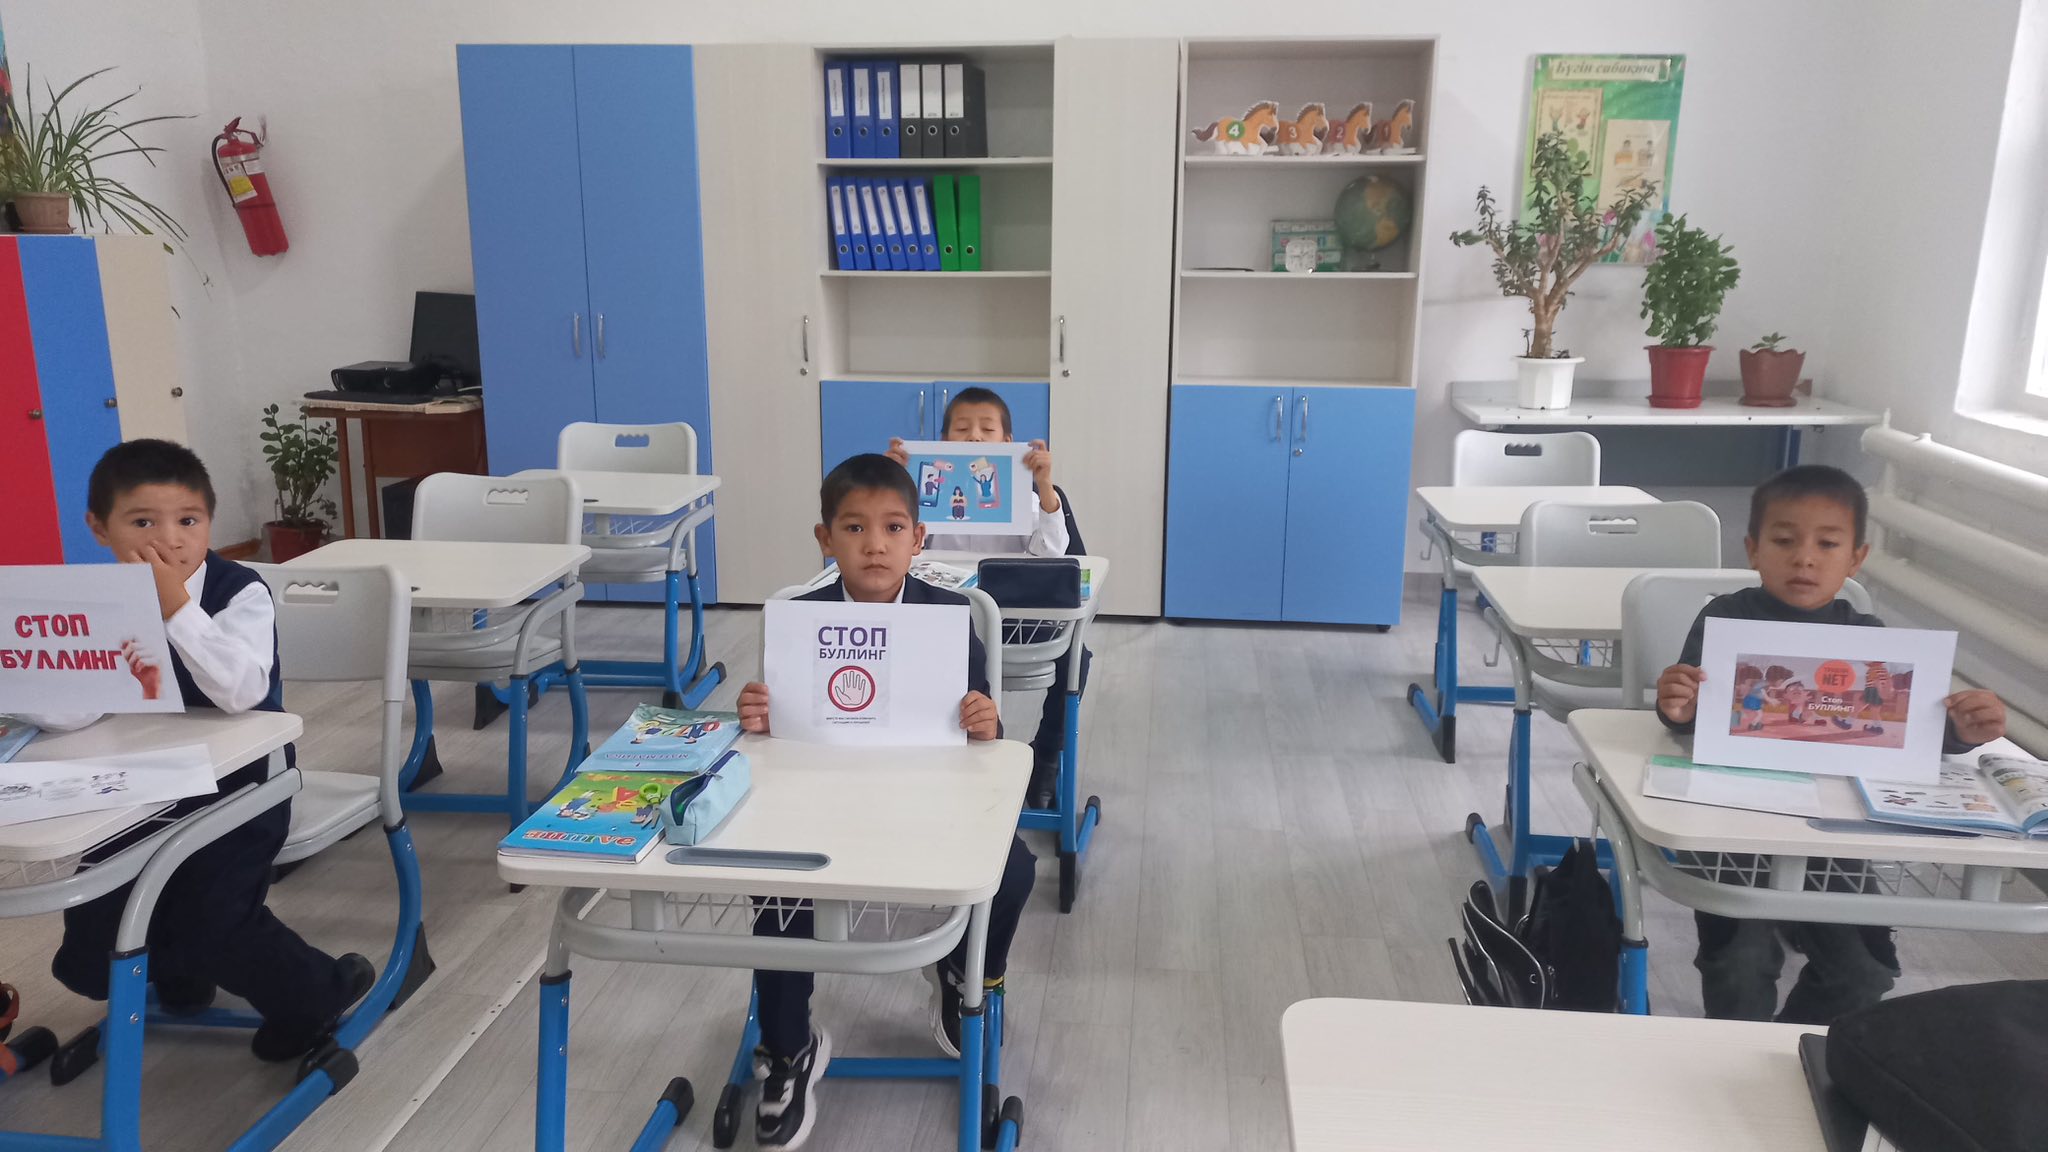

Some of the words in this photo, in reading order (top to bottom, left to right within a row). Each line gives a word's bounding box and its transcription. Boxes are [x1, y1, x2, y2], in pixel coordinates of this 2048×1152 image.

[1556, 61, 1592, 76] Бүгін
[1596, 62, 1655, 75] сабақта
[1228, 124, 1240, 137] 4
[1289, 127, 1297, 138] 3
[1336, 127, 1344, 138] 2
[15, 613, 90, 638] СТОП
[818, 626, 886, 647] СТОП
[0, 649, 122, 671] БУЛЛИНГ
[819, 648, 887, 660] БУЛЛИНГ
[1823, 674, 1849, 686] НЕТ
